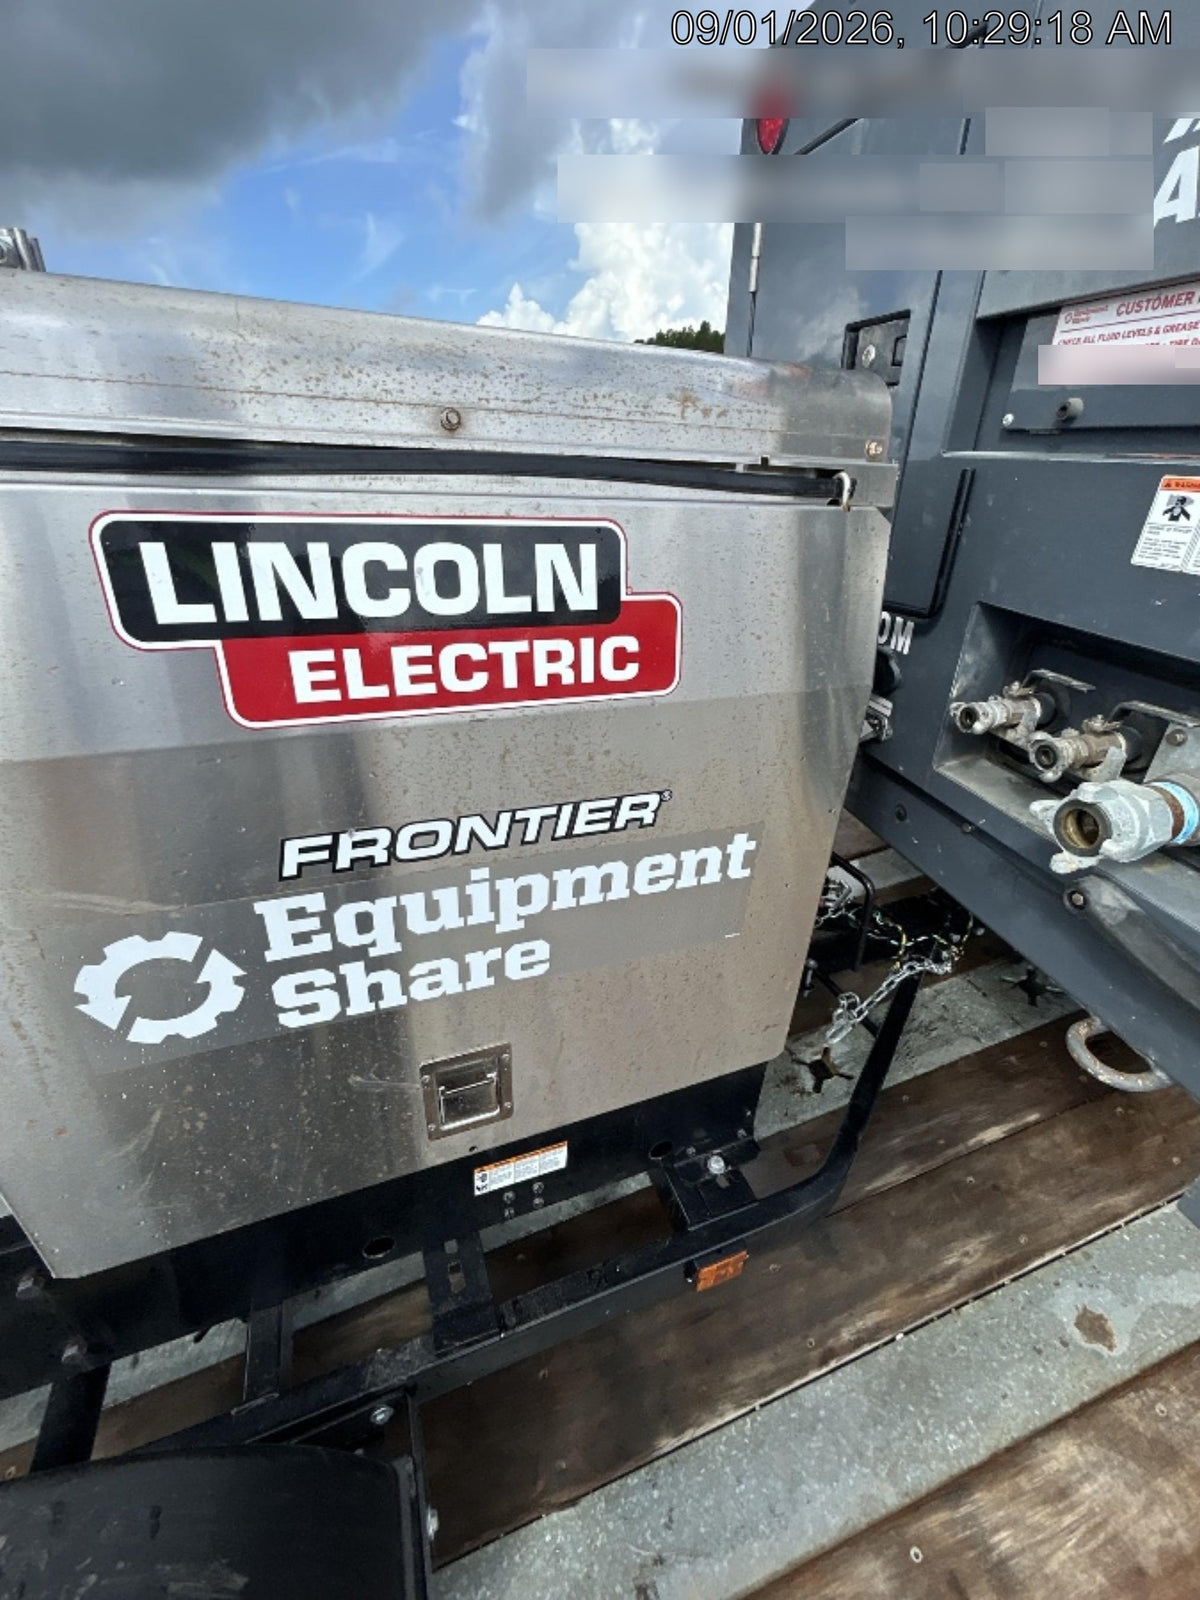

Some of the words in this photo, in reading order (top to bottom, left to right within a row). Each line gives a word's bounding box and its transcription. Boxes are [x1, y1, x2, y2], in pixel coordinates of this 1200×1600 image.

[1116, 291, 1196, 317] CUSTOMER
[1121, 327, 1153, 340] LEVELS
[1163, 321, 1200, 334] GREASE
[138, 540, 600, 626] LINCOLN
[288, 635, 641, 704] ELECTRIC
[253, 832, 756, 962] Equipment
[271, 939, 551, 1030] Share
